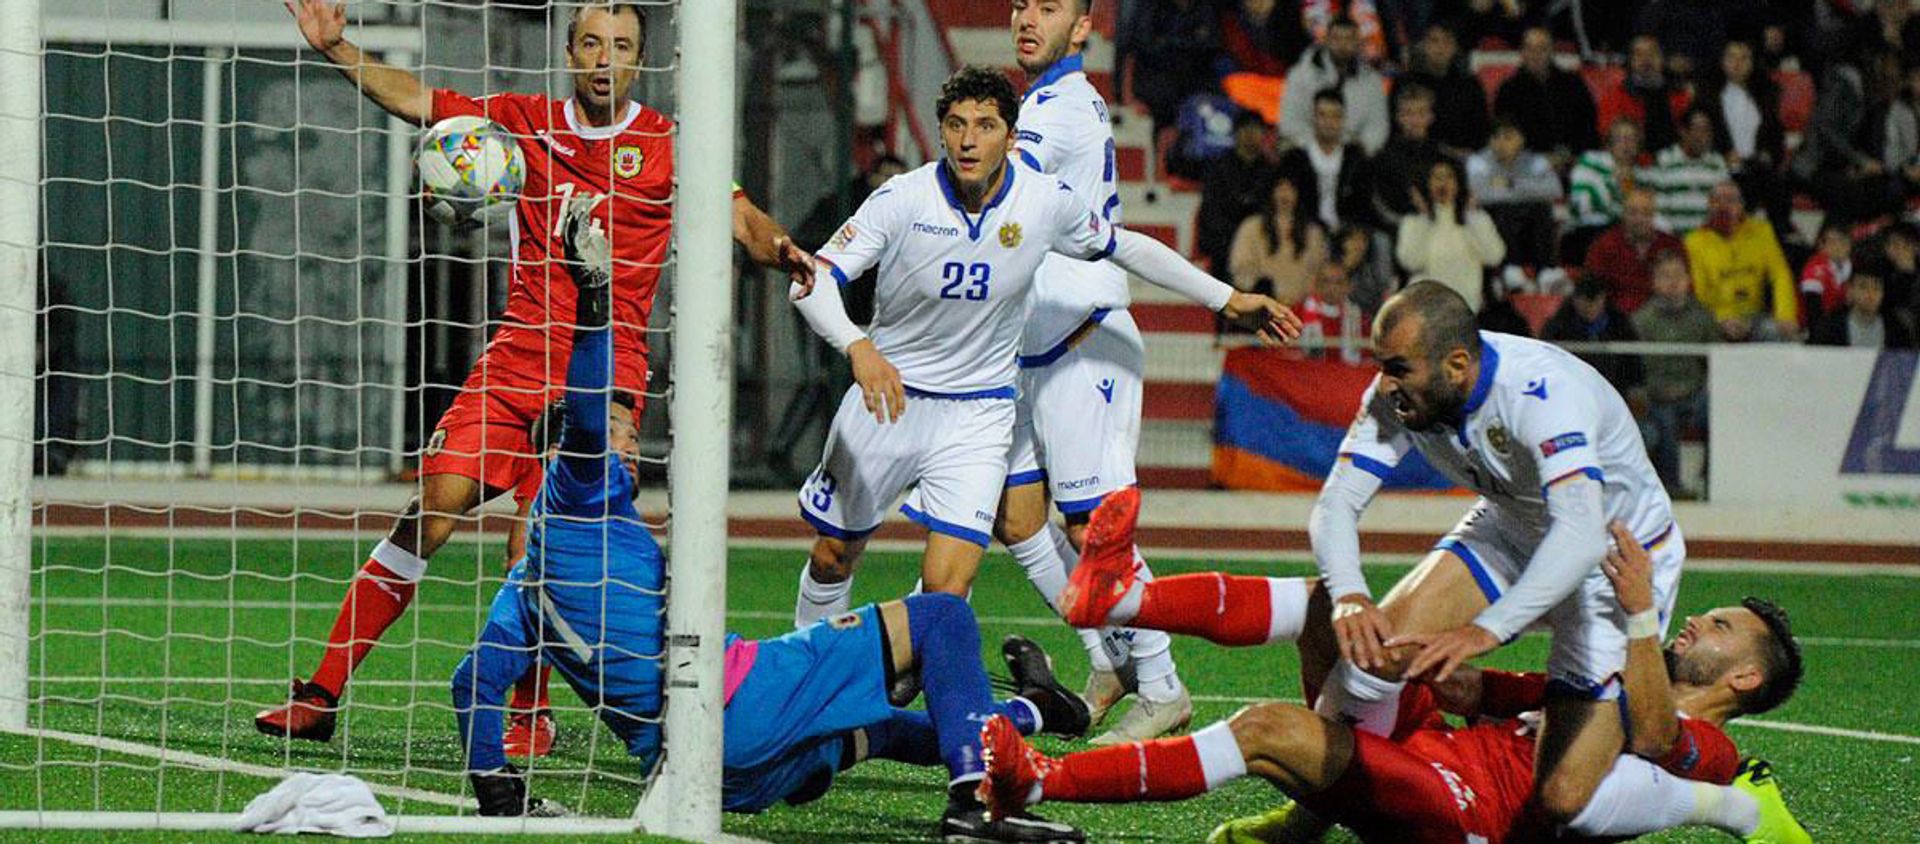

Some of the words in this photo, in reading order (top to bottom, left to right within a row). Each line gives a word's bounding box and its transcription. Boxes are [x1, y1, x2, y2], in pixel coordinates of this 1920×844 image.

[912, 222, 959, 236] macron
[940, 261, 991, 301] 23
[1057, 475, 1099, 490] macron
